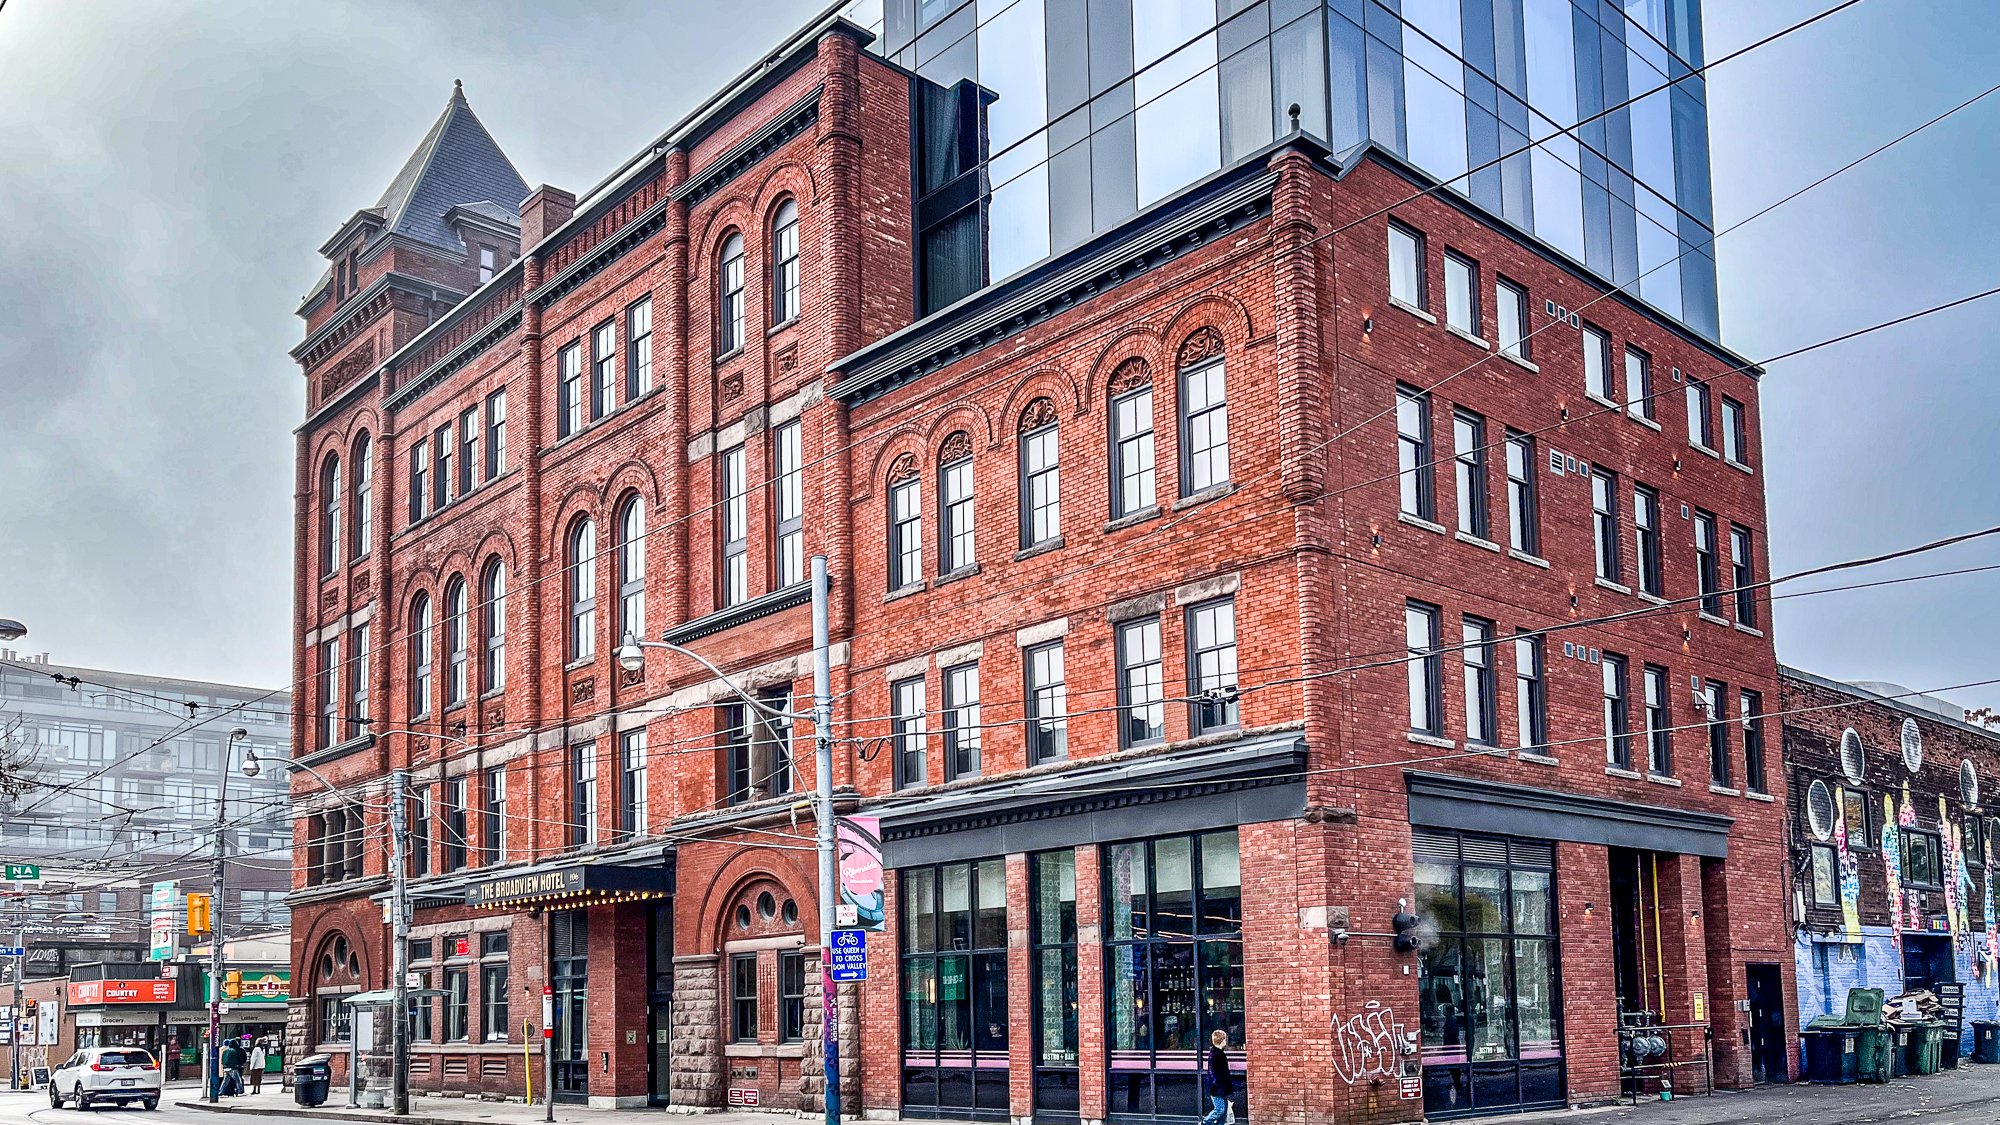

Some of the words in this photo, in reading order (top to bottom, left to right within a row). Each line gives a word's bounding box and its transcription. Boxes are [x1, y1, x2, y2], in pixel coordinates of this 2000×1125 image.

[843, 861, 878, 878] Riverside
[480, 883, 494, 900] THE
[495, 875, 539, 898] BROADVIEW
[540, 872, 565, 891] HOTEL
[843, 946, 859, 954] QUEEN
[844, 954, 863, 962] CROSS
[846, 962, 865, 970] VALLEY
[78, 983, 99, 999] COUNTRY
[105, 989, 138, 997] COUNTRY
